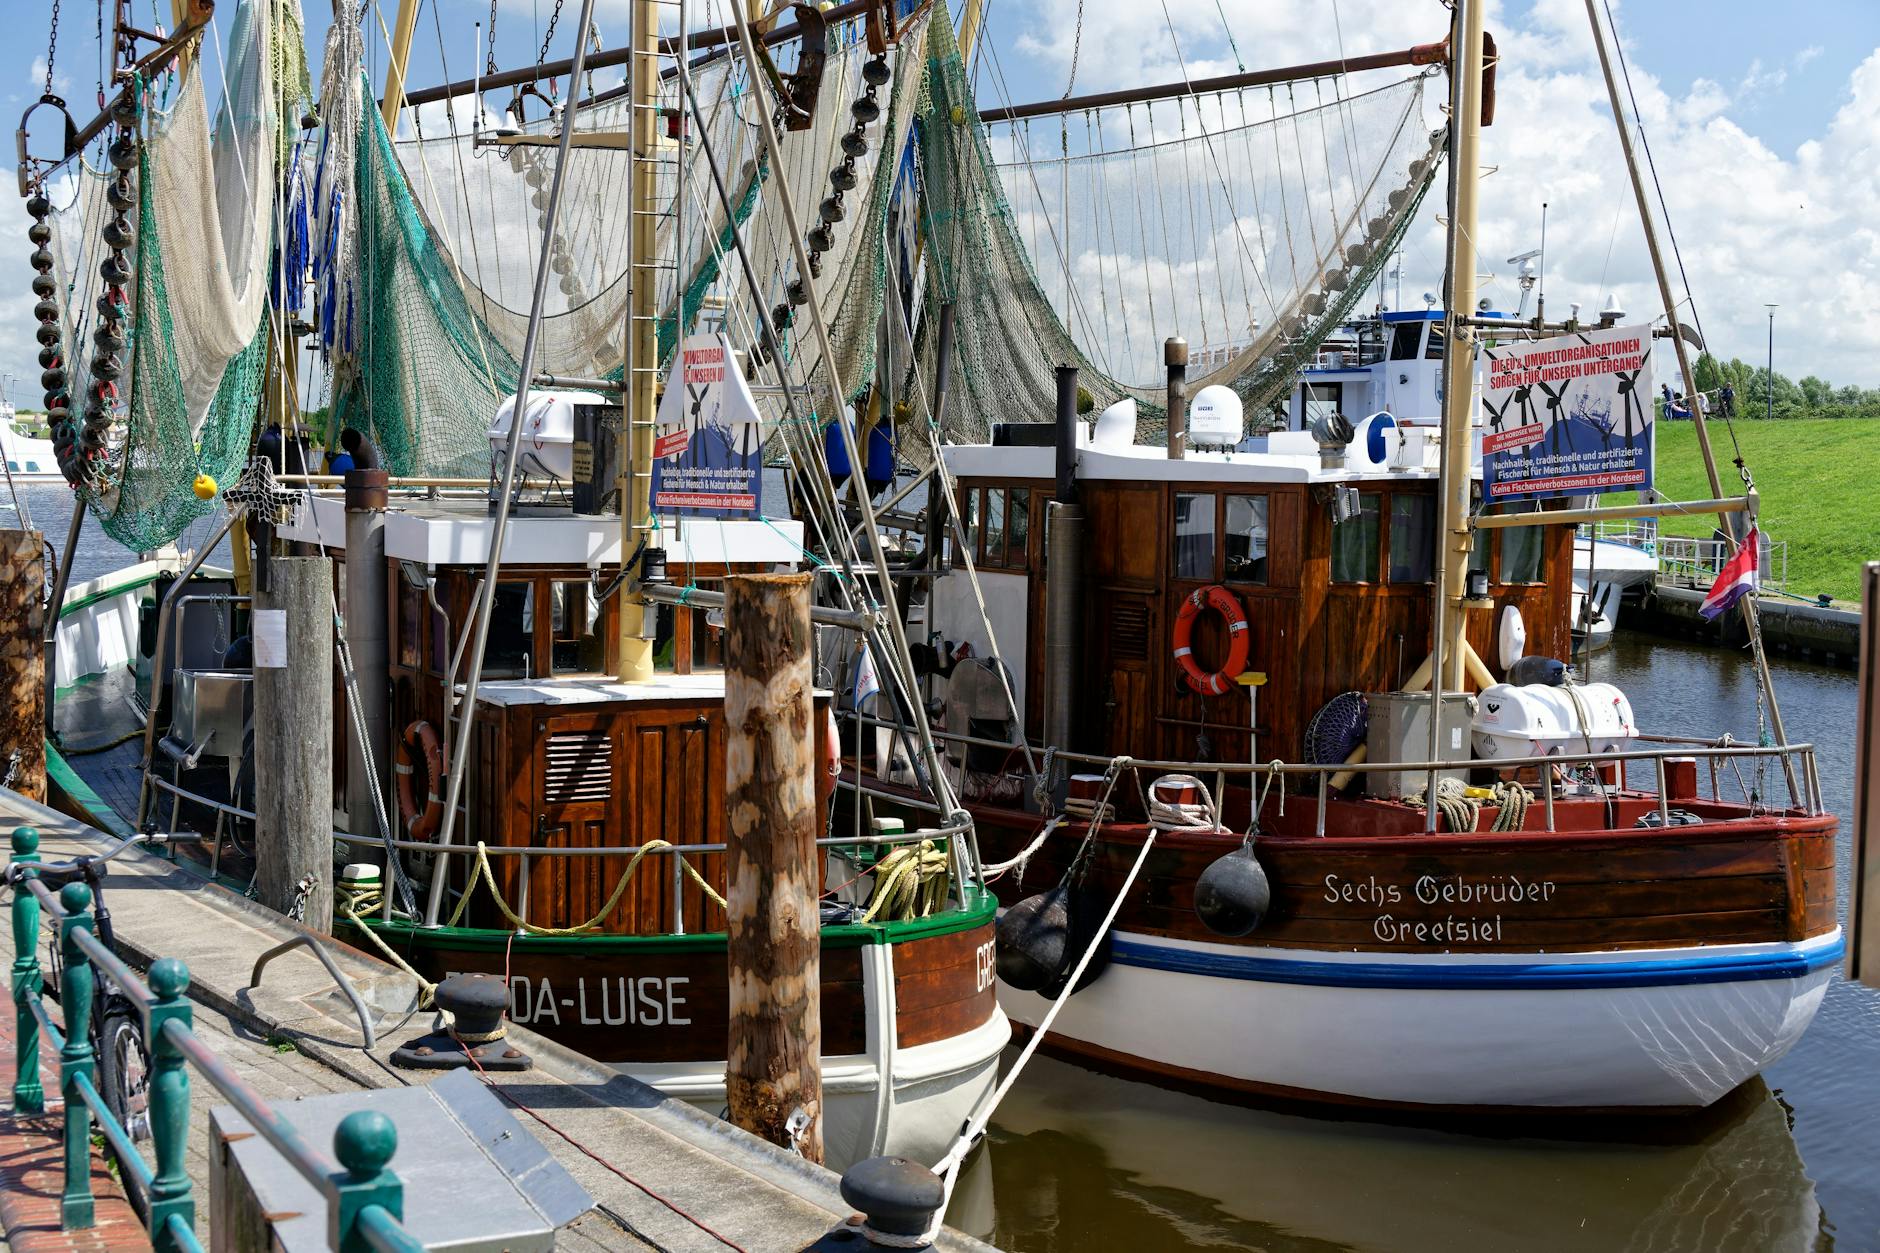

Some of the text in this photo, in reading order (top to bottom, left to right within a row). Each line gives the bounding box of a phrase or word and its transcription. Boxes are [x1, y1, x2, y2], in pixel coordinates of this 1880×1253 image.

[1492, 338, 1640, 373] DIE EU & UMWELTORGANISATIONEN
[691, 368, 716, 383] UNSEREN
[1490, 356, 1643, 390] SORGEN FÜR UNSEREN UNTERGANG!
[1496, 425, 1542, 442] DIE NORDSEE WIRD
[1503, 434, 1543, 448] INDUSTRIEPARK!
[1492, 447, 1643, 470] Nachhaltige, traditionelle und zertifizierte
[1498, 458, 1636, 480] Fischerei für Mensch & Natur erhalten!
[686, 480, 704, 489] Mensch
[710, 480, 725, 490] Natur
[1492, 472, 1643, 494] Keine Fischereiverbotszonen in der Nordsee!
[722, 496, 732, 506] der
[1323, 874, 1556, 908] Sechs Gebrüder
[1374, 913, 1502, 942] Greetsiel
